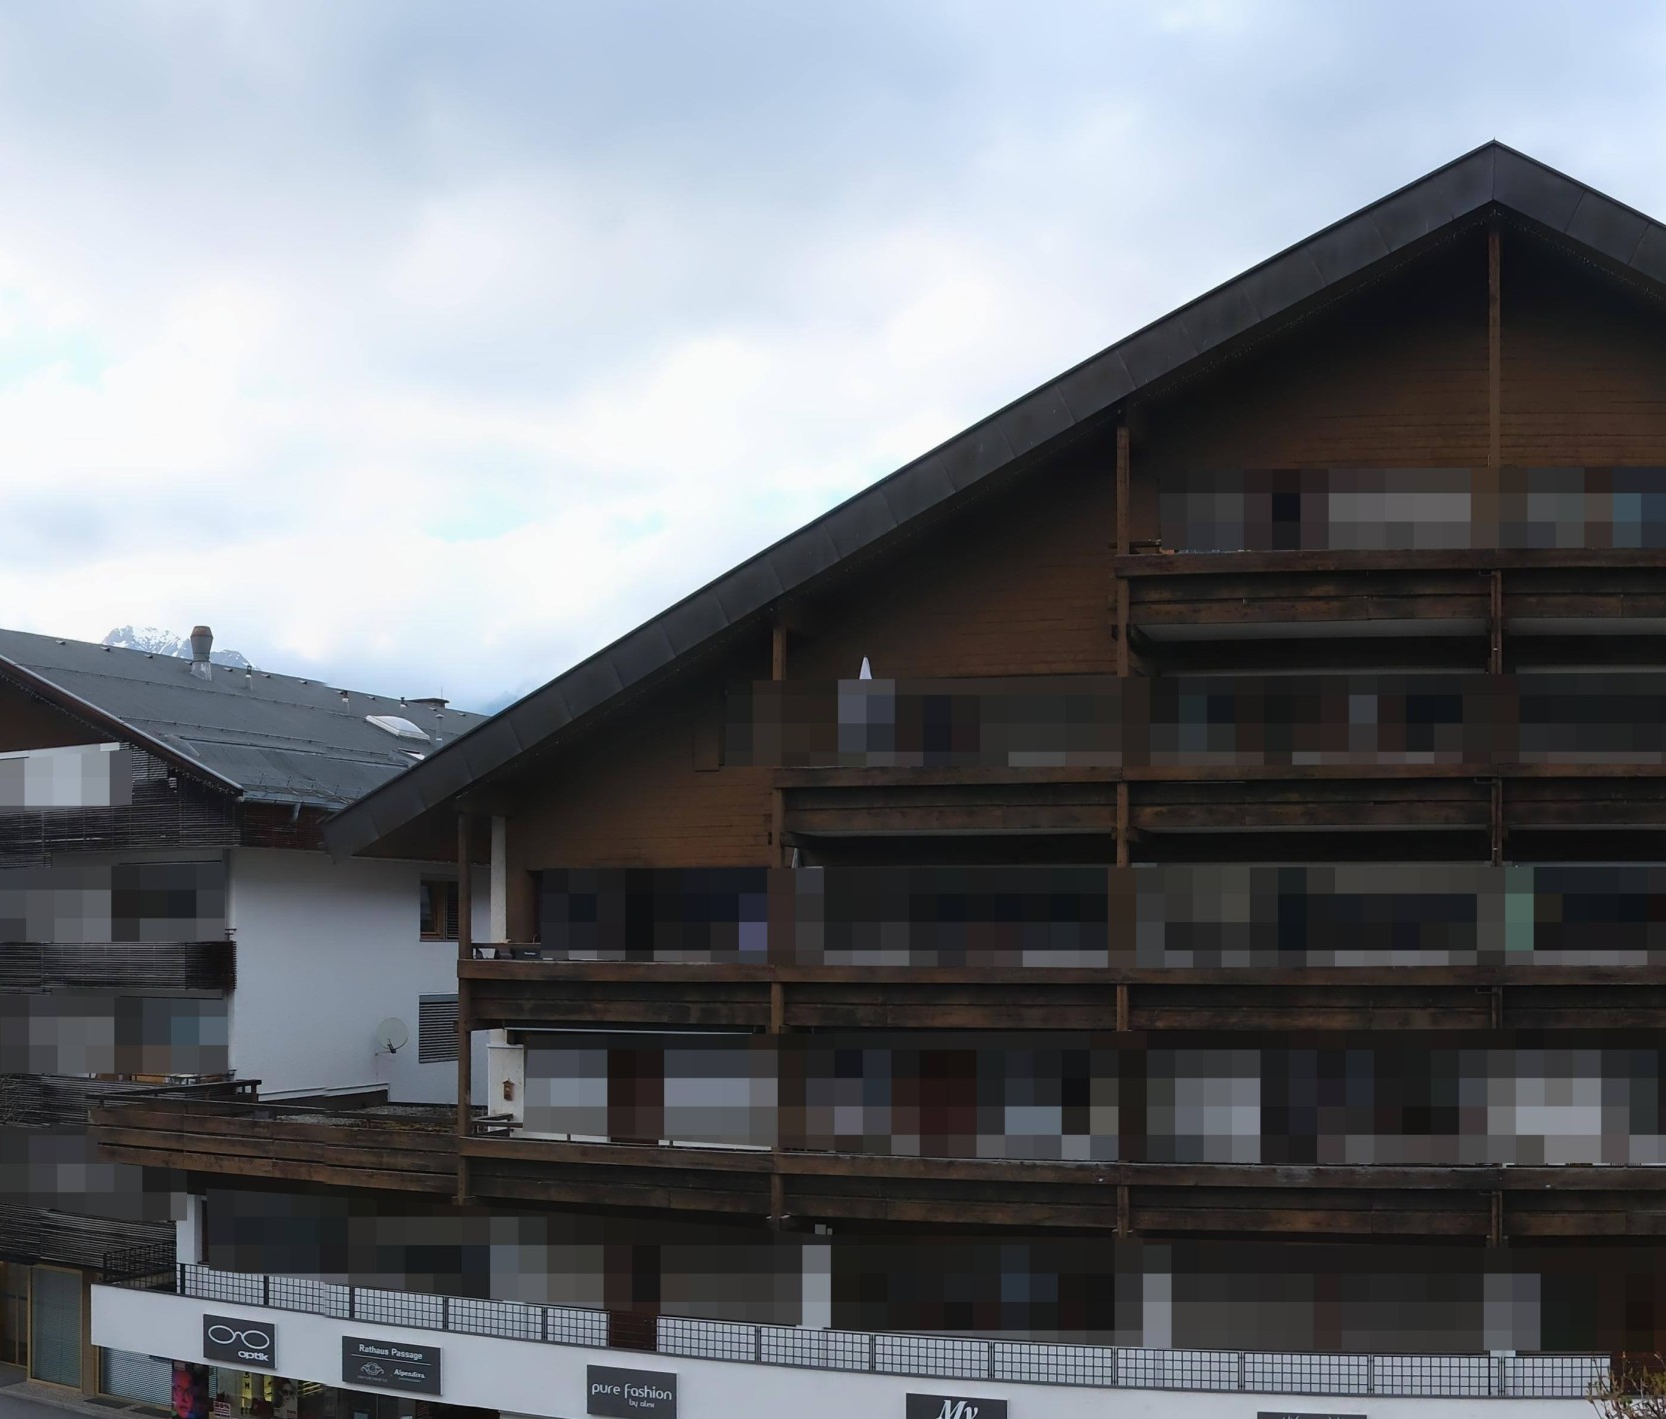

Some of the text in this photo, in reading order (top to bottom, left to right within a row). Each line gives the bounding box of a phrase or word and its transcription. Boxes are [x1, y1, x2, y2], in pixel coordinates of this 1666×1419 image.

[237, 1350, 269, 1362] optik
[359, 1344, 423, 1360] Rathaus Passage
[591, 1383, 672, 1400] pure fashion
